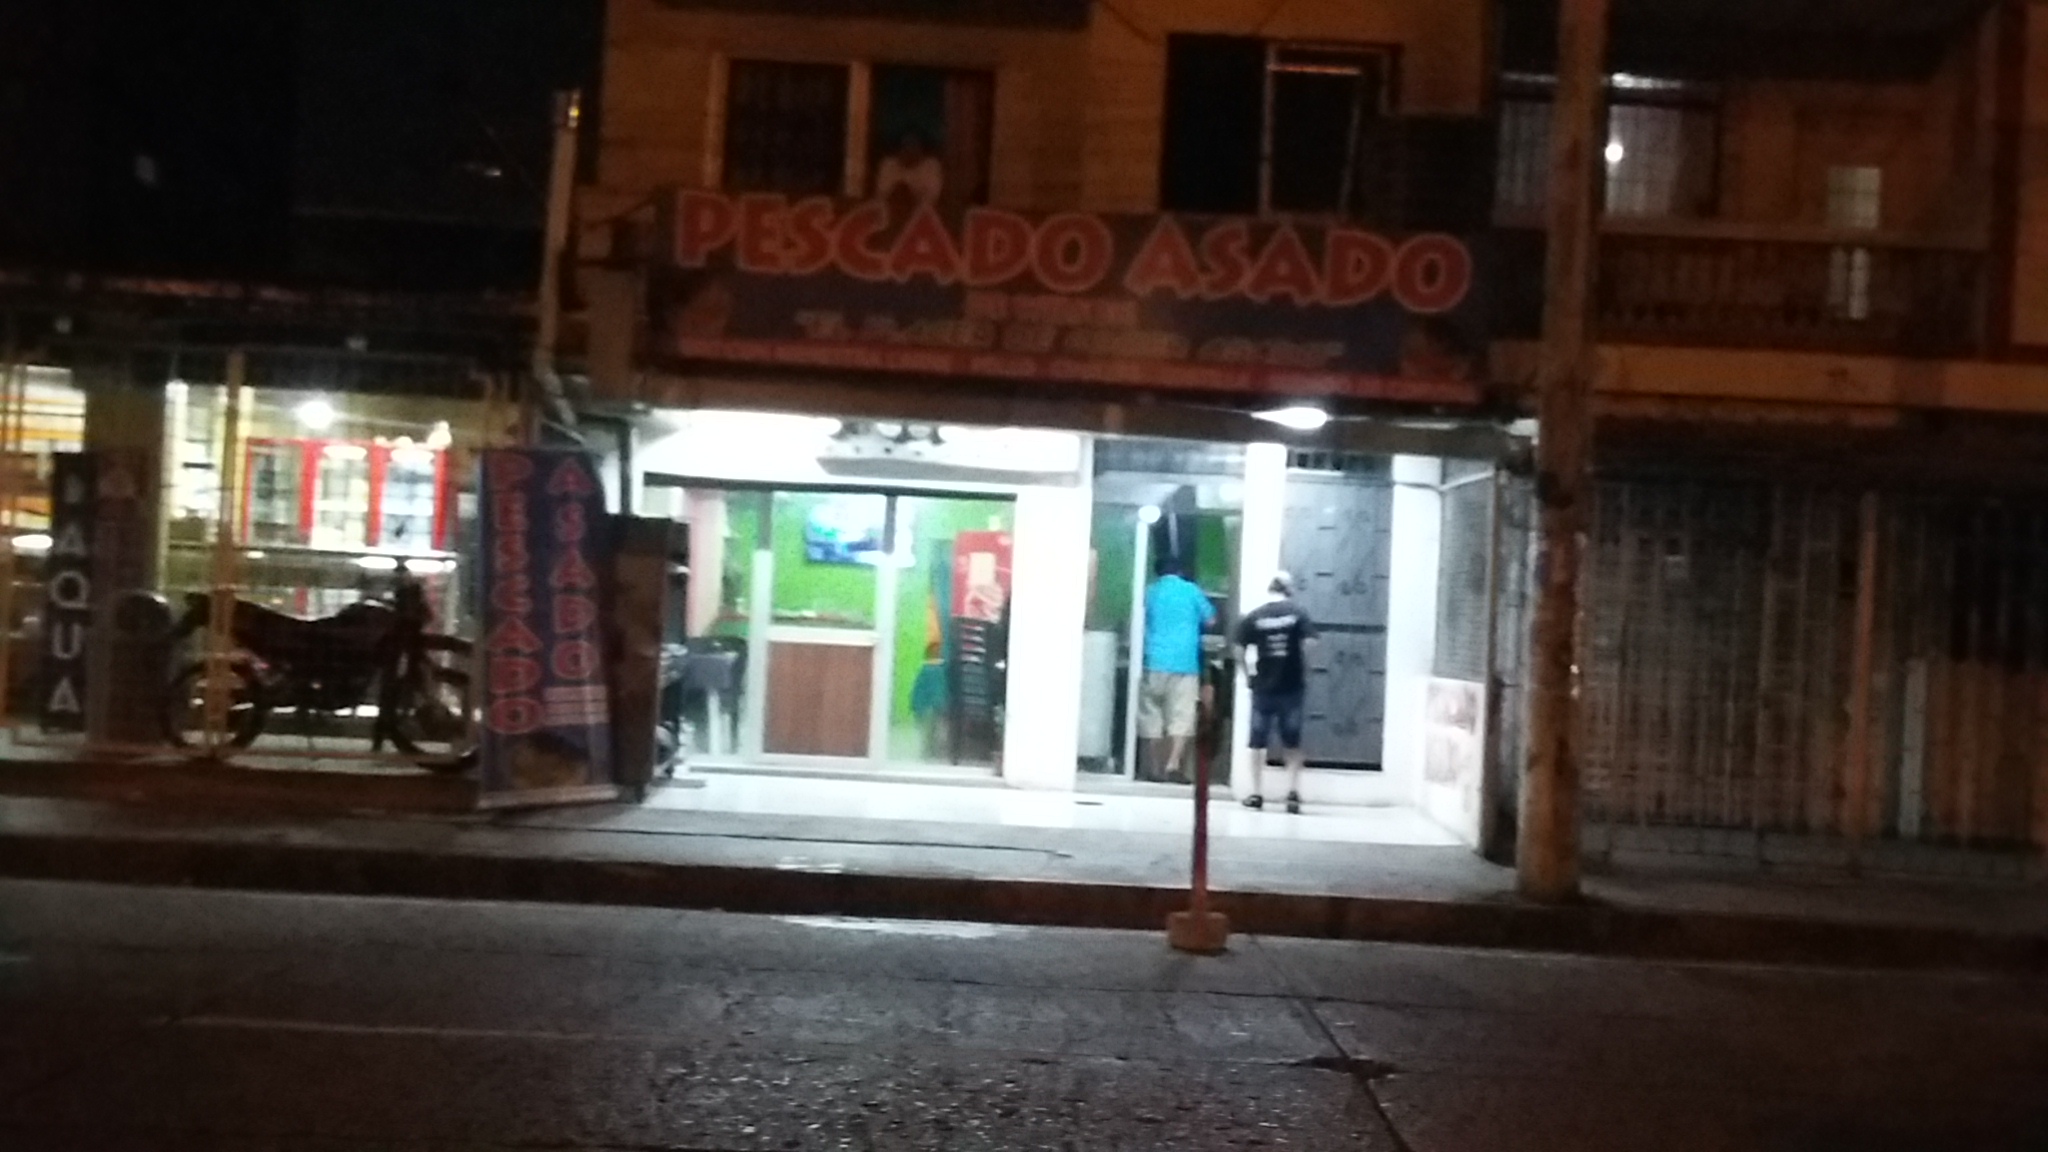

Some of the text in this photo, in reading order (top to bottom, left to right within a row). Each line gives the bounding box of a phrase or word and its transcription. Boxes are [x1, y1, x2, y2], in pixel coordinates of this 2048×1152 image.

[678, 191, 1471, 312] PESCADO ASADO
[487, 452, 543, 734] PESCADO
[547, 454, 601, 680] ASADO
